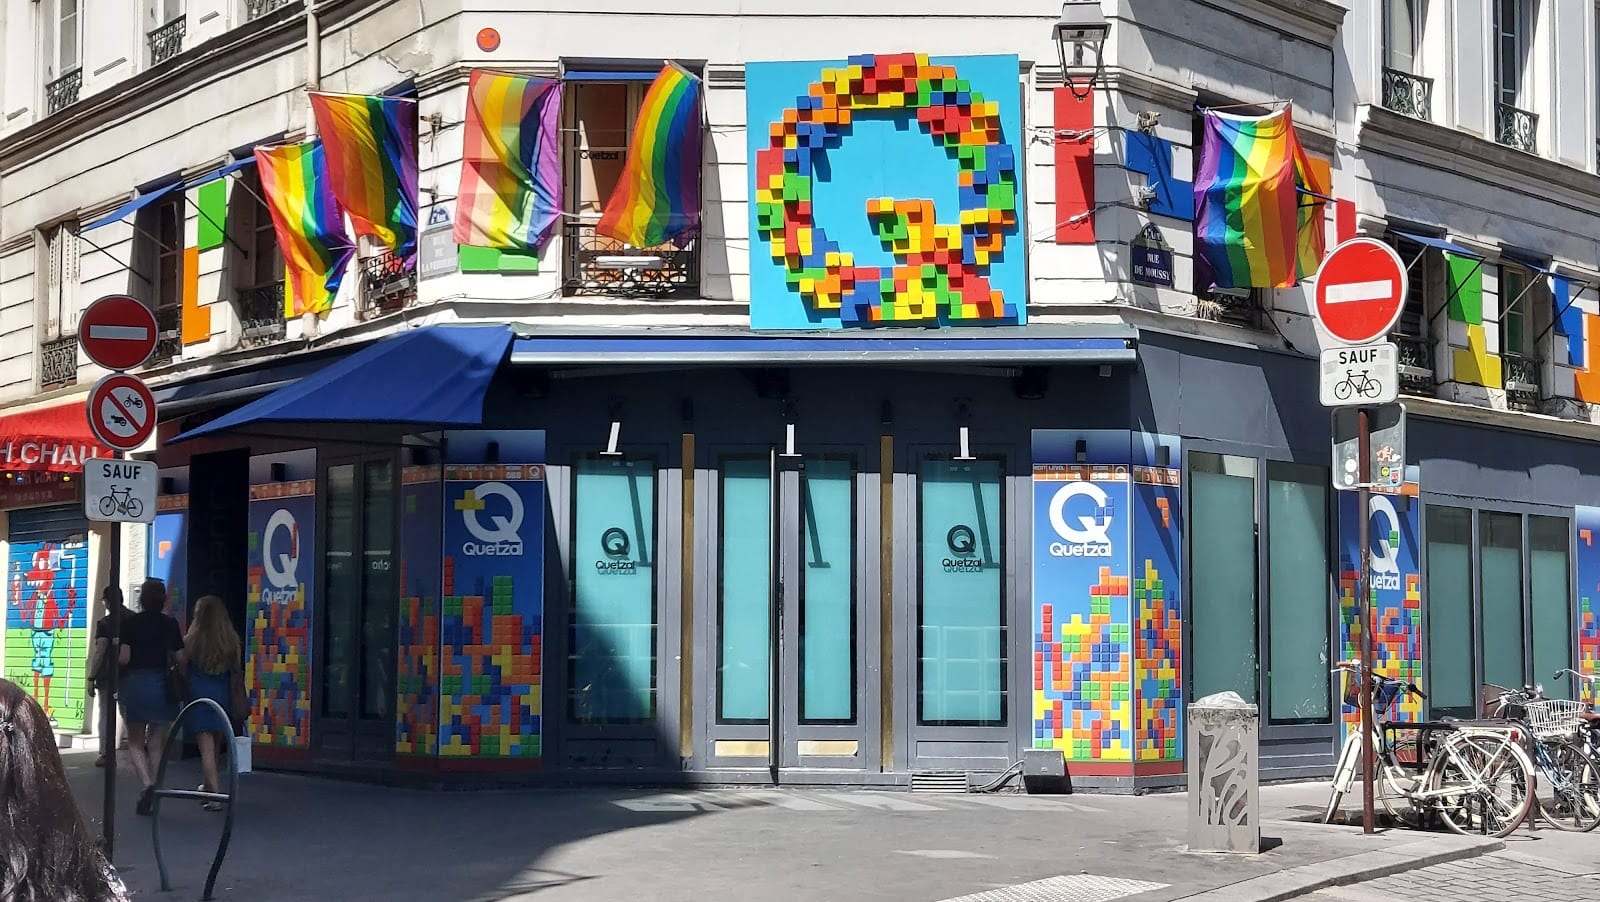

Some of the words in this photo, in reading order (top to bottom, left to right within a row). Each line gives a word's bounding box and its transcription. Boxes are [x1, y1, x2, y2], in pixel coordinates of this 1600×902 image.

[1147, 253, 1160, 264] RUE
[1134, 265, 1144, 276] DE
[1146, 267, 1170, 280] MOUSSY
[1339, 348, 1377, 364] SAUF
[21, 442, 98, 466] CHAU
[103, 463, 142, 480] SAUF
[463, 482, 524, 543] Q
[1049, 482, 1112, 543] Q
[601, 527, 630, 556] Q
[947, 524, 976, 553] Q
[463, 541, 523, 555] Quetzal
[1050, 541, 1112, 557] Quetzal
[596, 560, 636, 569] Quetzal
[942, 558, 982, 567] Quetzal
[1370, 573, 1400, 590] uetzal
